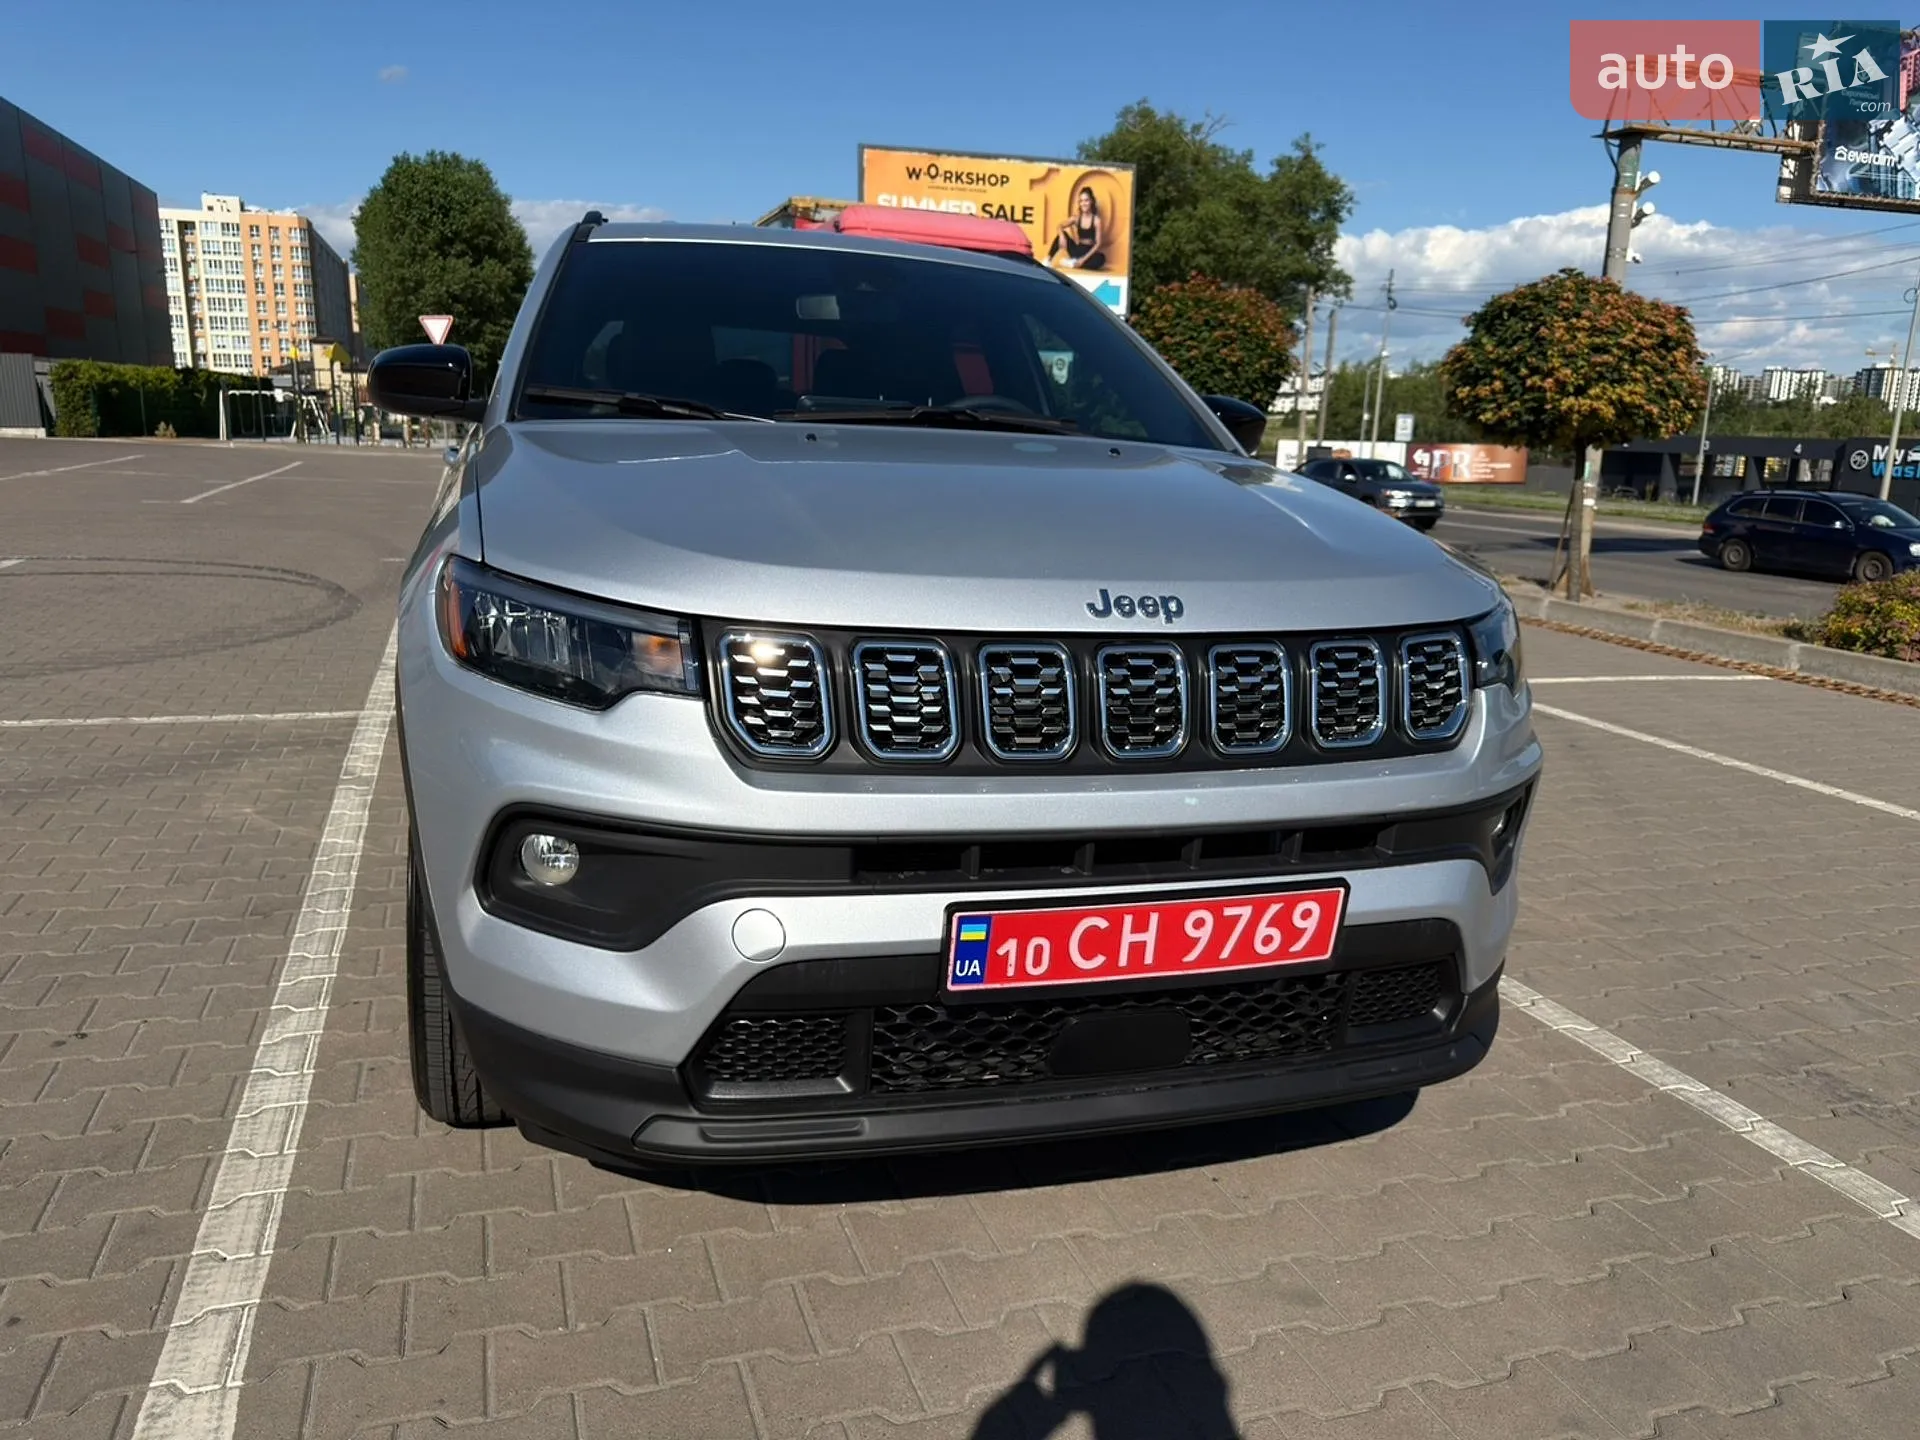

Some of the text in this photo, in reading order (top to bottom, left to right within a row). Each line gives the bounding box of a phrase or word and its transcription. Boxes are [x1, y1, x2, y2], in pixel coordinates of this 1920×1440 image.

[1847, 150, 1896, 166] everdim
[981, 203, 1035, 224] SALE
[1873, 444, 1905, 465] My
[1086, 588, 1184, 624] Jeep
[996, 899, 1321, 977] 10 CH 9769
[956, 960, 981, 976] UA
